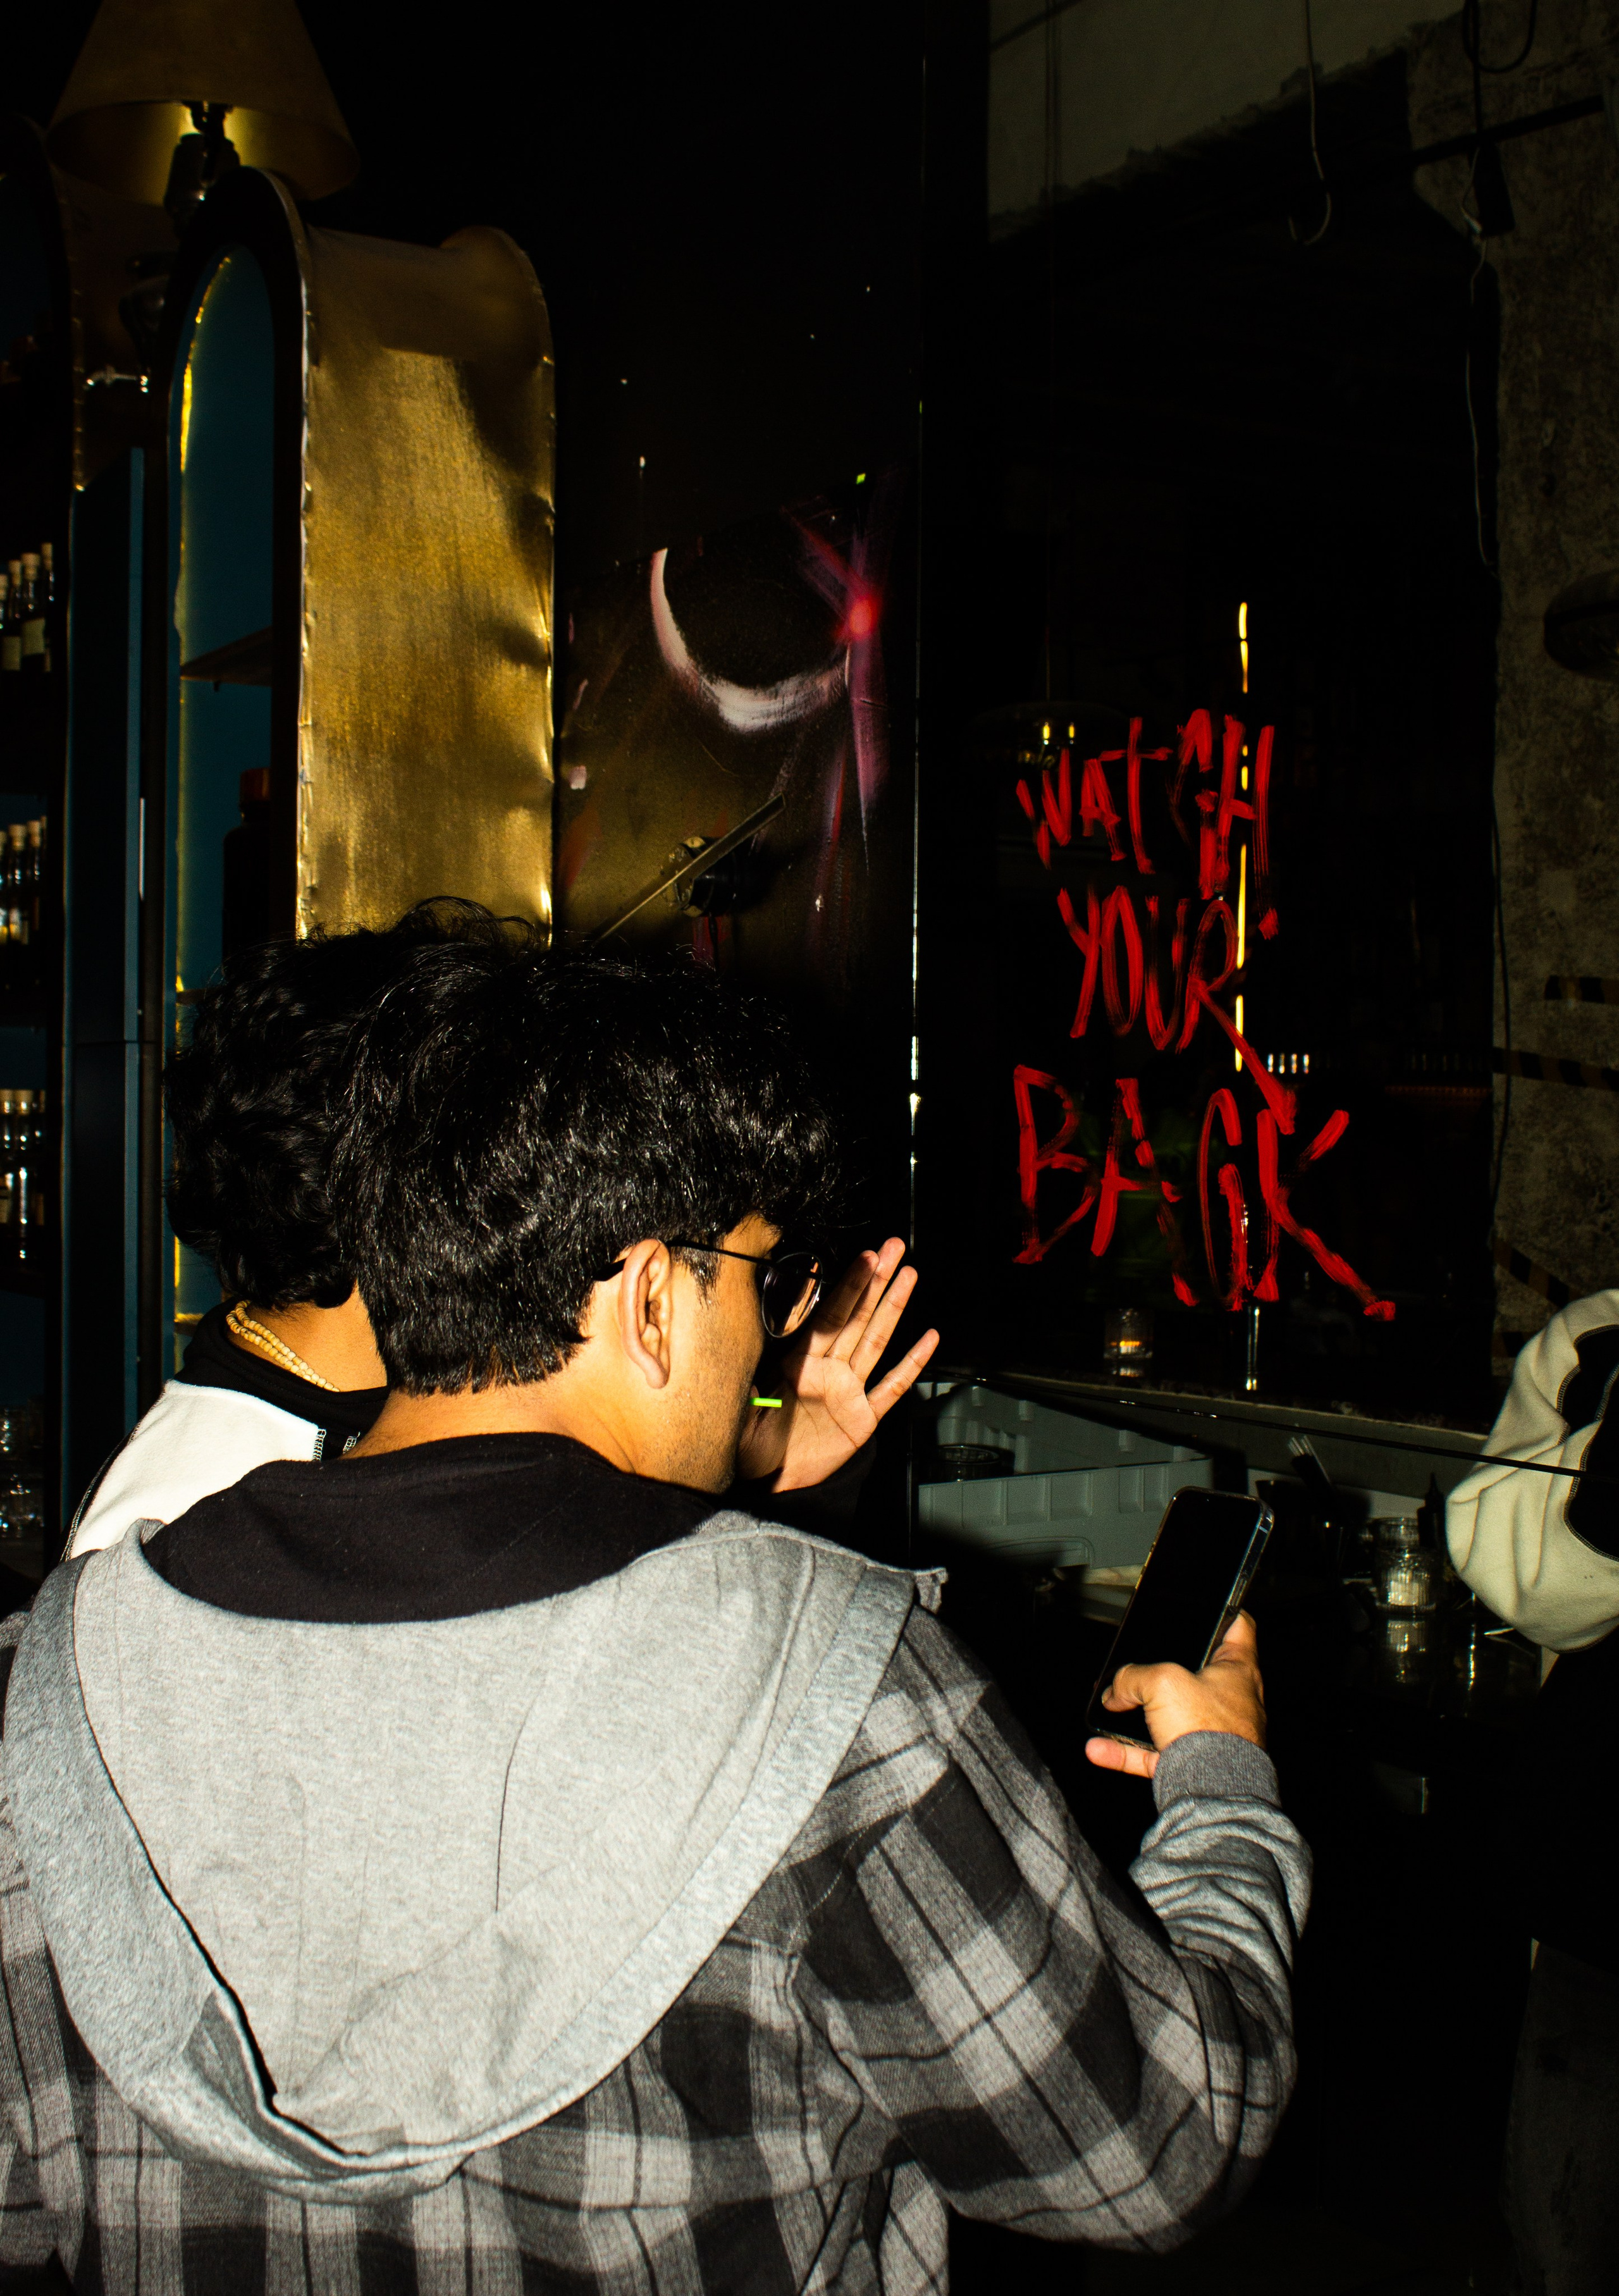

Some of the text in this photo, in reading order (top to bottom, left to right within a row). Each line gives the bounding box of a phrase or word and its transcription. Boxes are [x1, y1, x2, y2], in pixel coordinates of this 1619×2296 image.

[1016, 708, 1278, 940] WATCH
[1057, 884, 1295, 1135] YOUR
[1013, 1065, 1396, 1321] BACK
